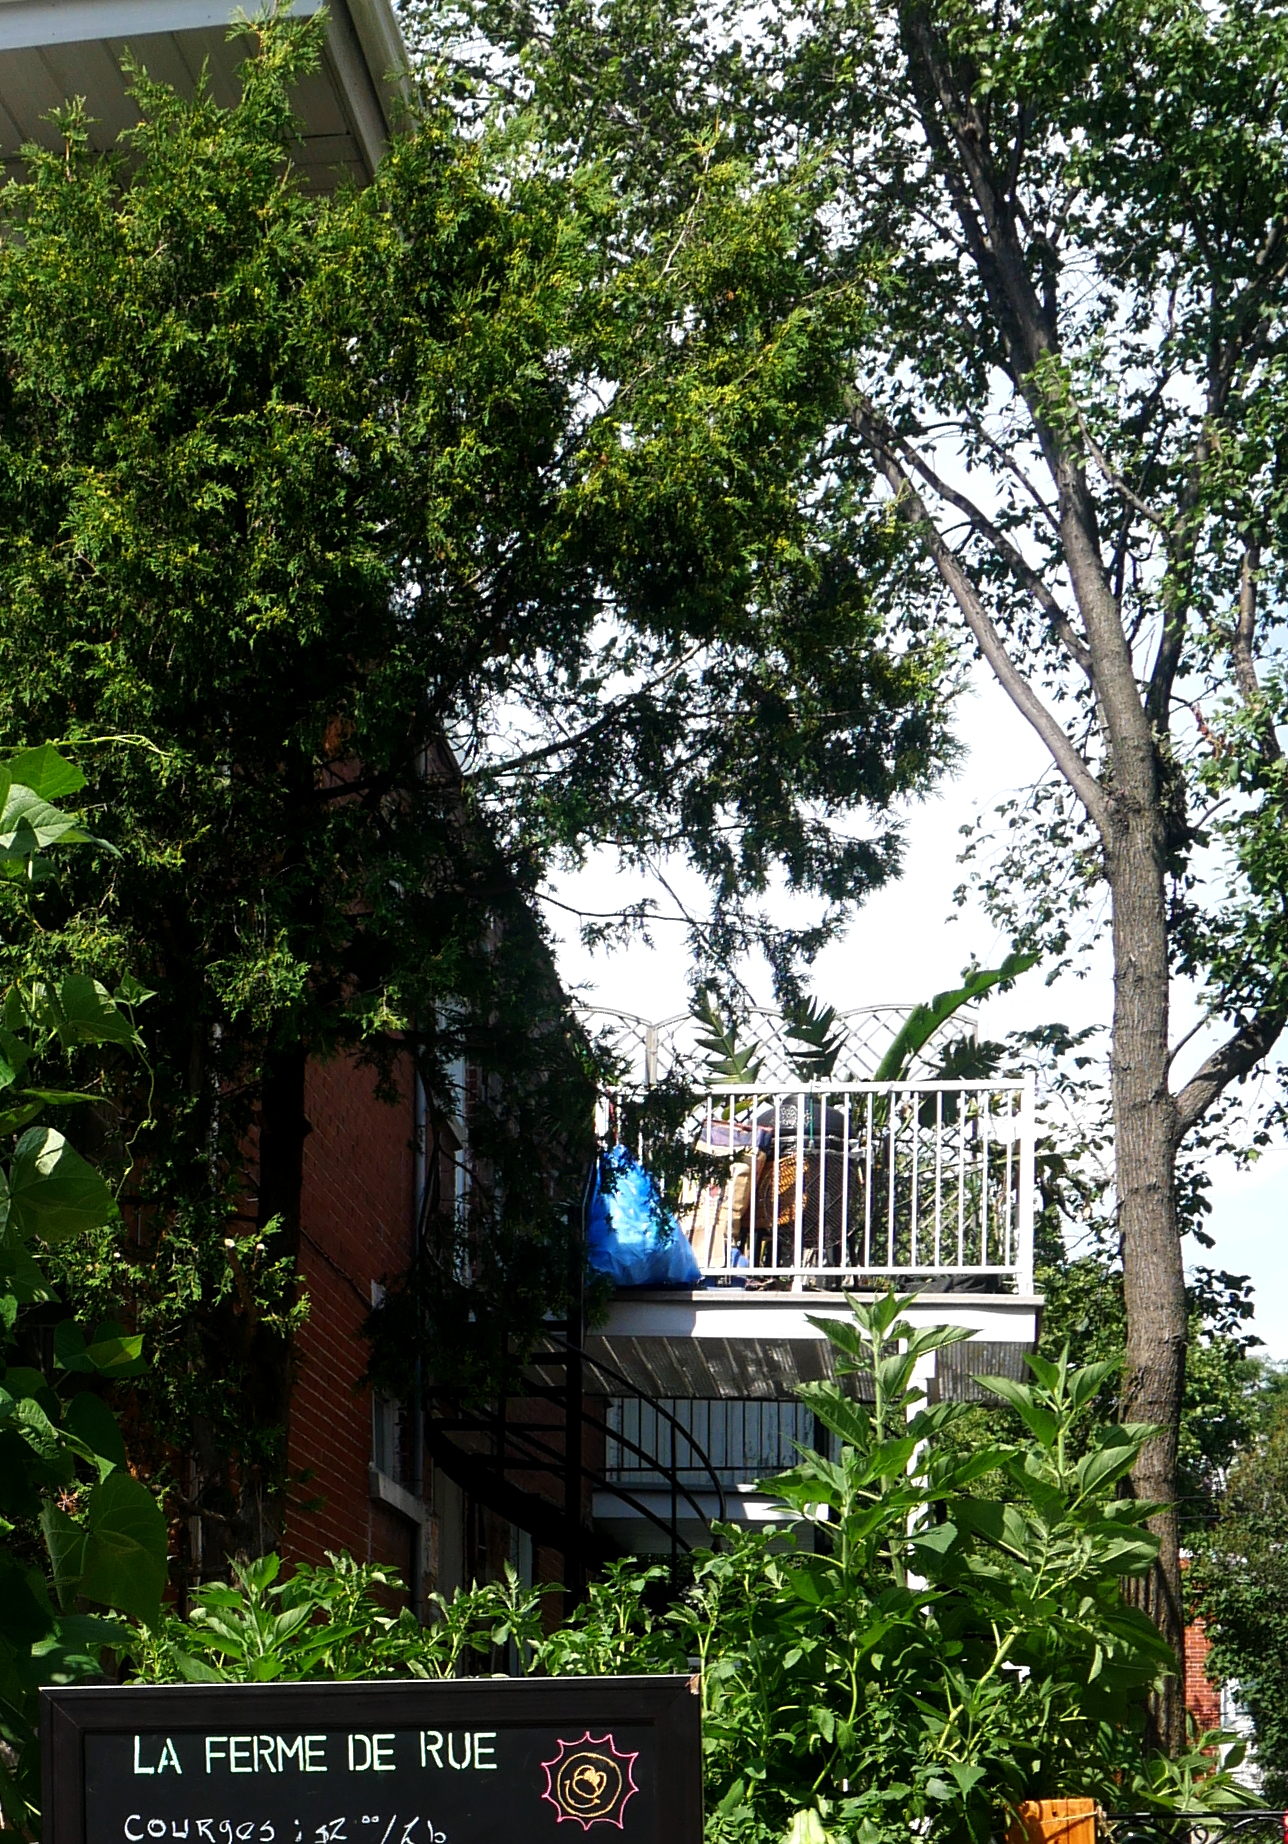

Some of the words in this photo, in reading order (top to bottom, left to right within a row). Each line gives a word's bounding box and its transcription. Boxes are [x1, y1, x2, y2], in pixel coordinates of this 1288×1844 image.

[134, 1735, 182, 1774] LA
[205, 1734, 328, 1773] FERME
[348, 1733, 396, 1771] DE
[420, 1730, 497, 1770] RUE
